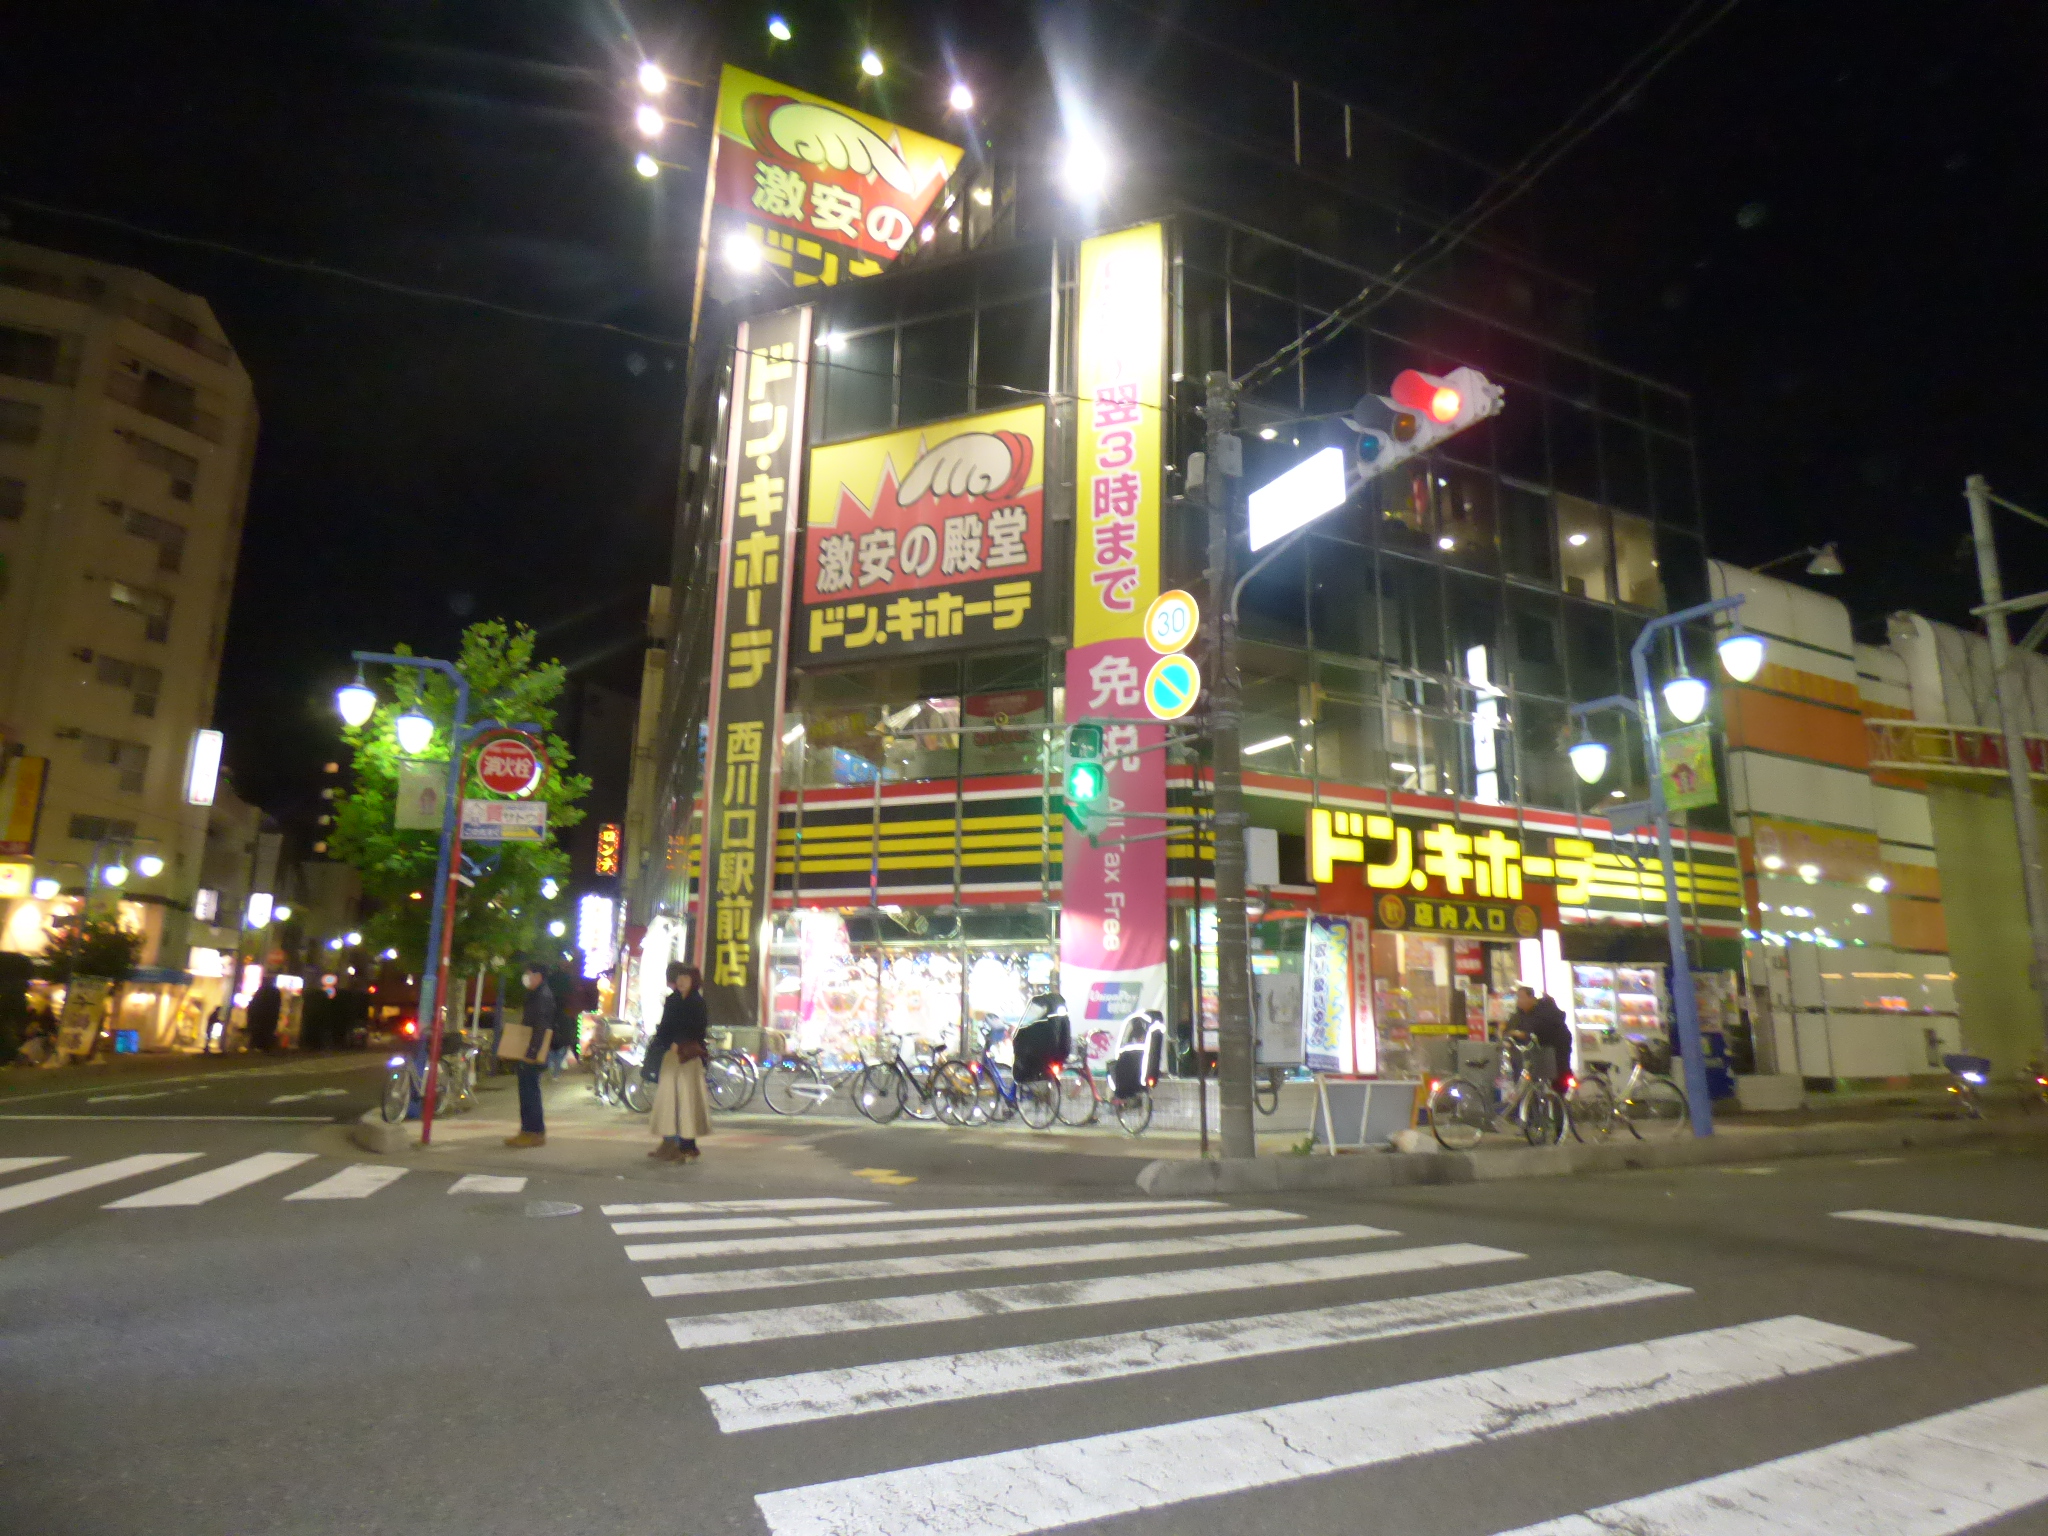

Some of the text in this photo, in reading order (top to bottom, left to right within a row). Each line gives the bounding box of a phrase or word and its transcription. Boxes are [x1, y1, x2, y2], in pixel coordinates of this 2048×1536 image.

[752, 160, 914, 251] 激安の
[1094, 382, 1139, 610] 翌3時まで
[816, 505, 1028, 593] 激安の殿堂
[1157, 607, 1185, 636] 30
[484, 756, 533, 778] 消火栓
[714, 721, 764, 986] 西川口駅前店
[1103, 892, 1125, 951] Free
